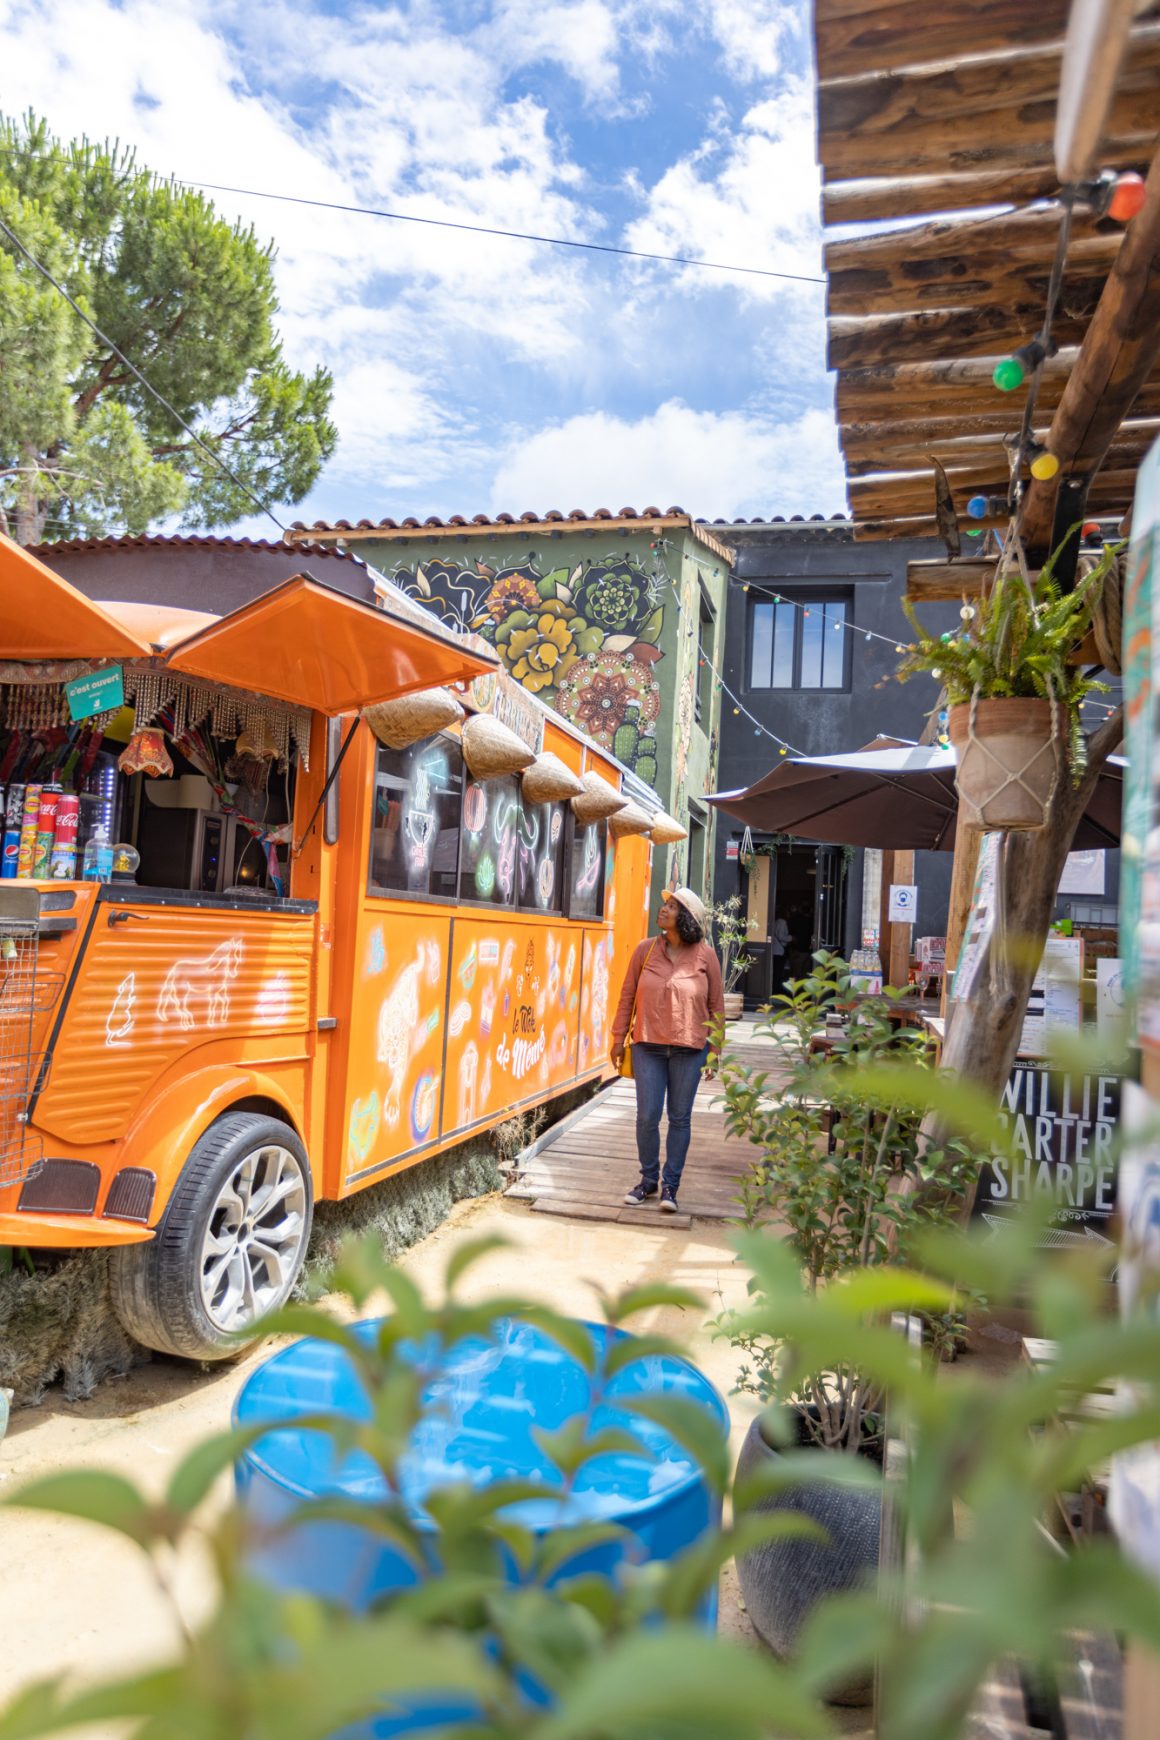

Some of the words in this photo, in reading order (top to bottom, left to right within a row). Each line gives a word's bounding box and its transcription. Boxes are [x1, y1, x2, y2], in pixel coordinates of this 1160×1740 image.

[70, 683, 90, 697] c'est
[91, 673, 119, 689] ouvert
[496, 1031, 510, 1071] de
[1000, 1070, 1117, 1124] WILLIE
[990, 1156, 1113, 1210] SHARPE
